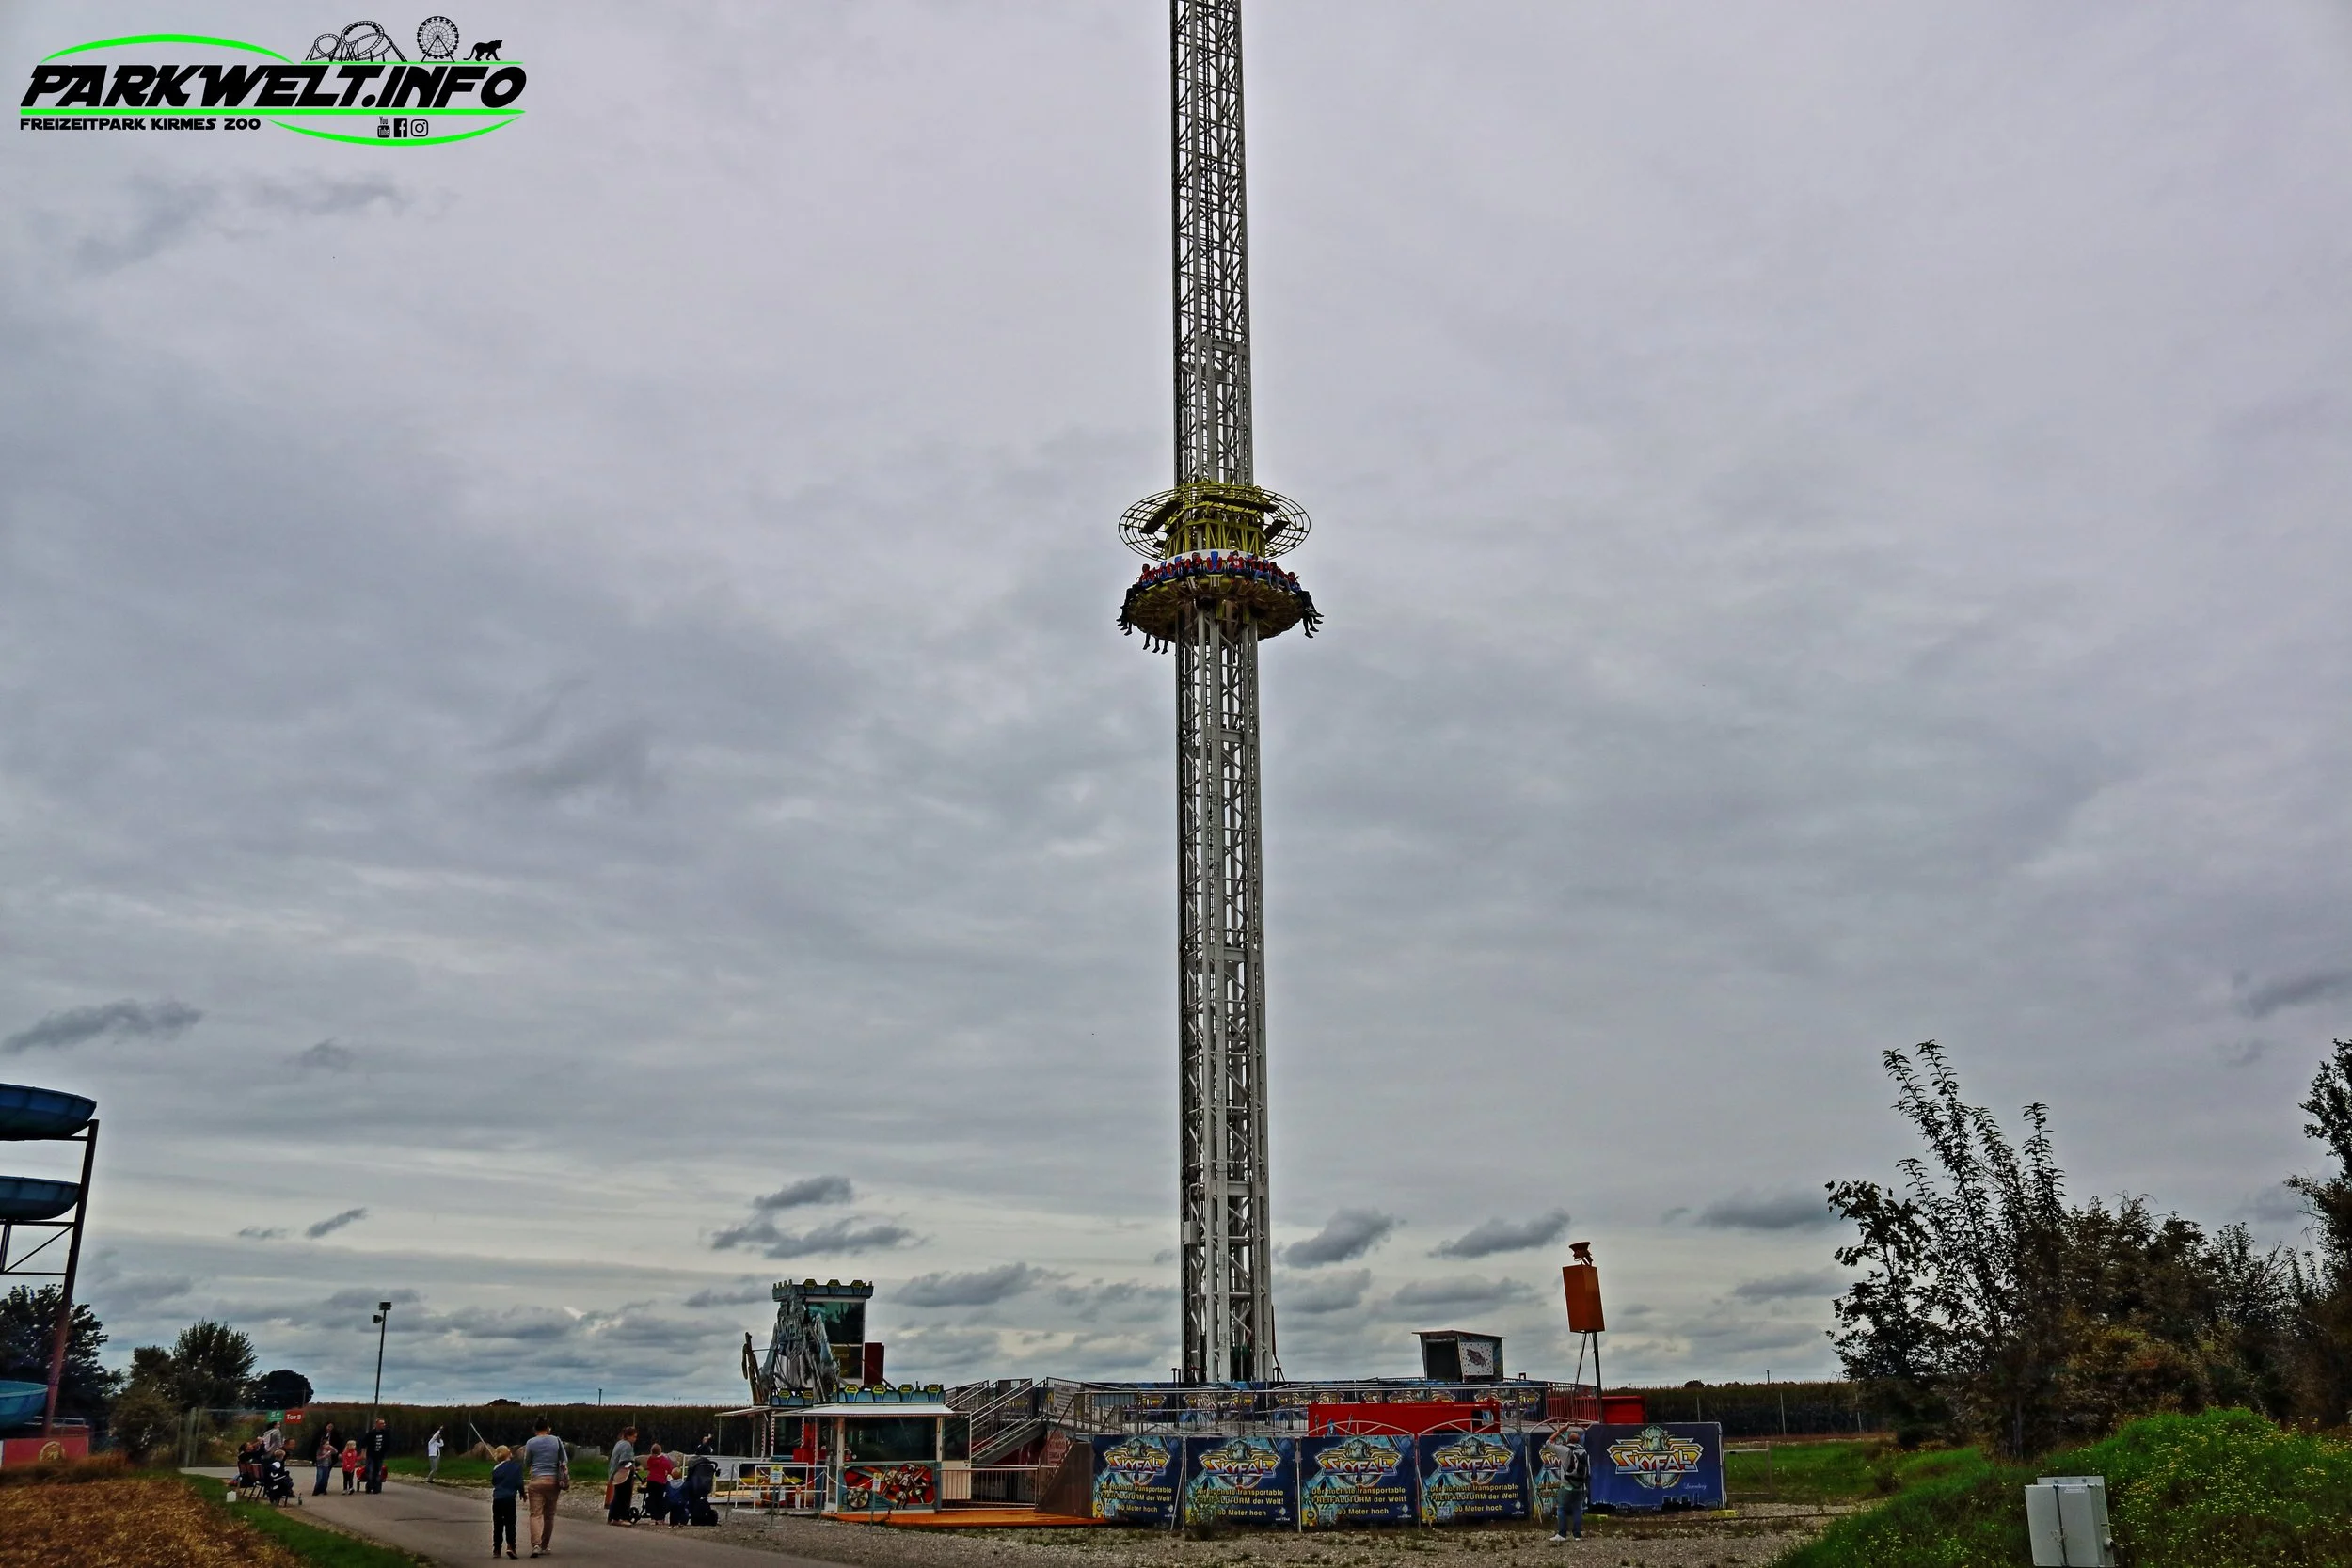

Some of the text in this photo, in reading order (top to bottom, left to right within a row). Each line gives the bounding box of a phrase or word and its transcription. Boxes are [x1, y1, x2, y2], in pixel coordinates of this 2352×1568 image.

[1109, 1455, 1165, 1473] SKYFALL
[1205, 1458, 1273, 1475] SKYFALL
[1323, 1457, 1394, 1473] SKYFALL
[1440, 1454, 1508, 1471] SKYFALL
[1617, 1449, 1697, 1473] SKYFALL
[1237, 1489, 1284, 1497] transportable
[1358, 1486, 1406, 1496] transportable
[1473, 1483, 1518, 1493] transportable
[1228, 1508, 1248, 1516] Meter
